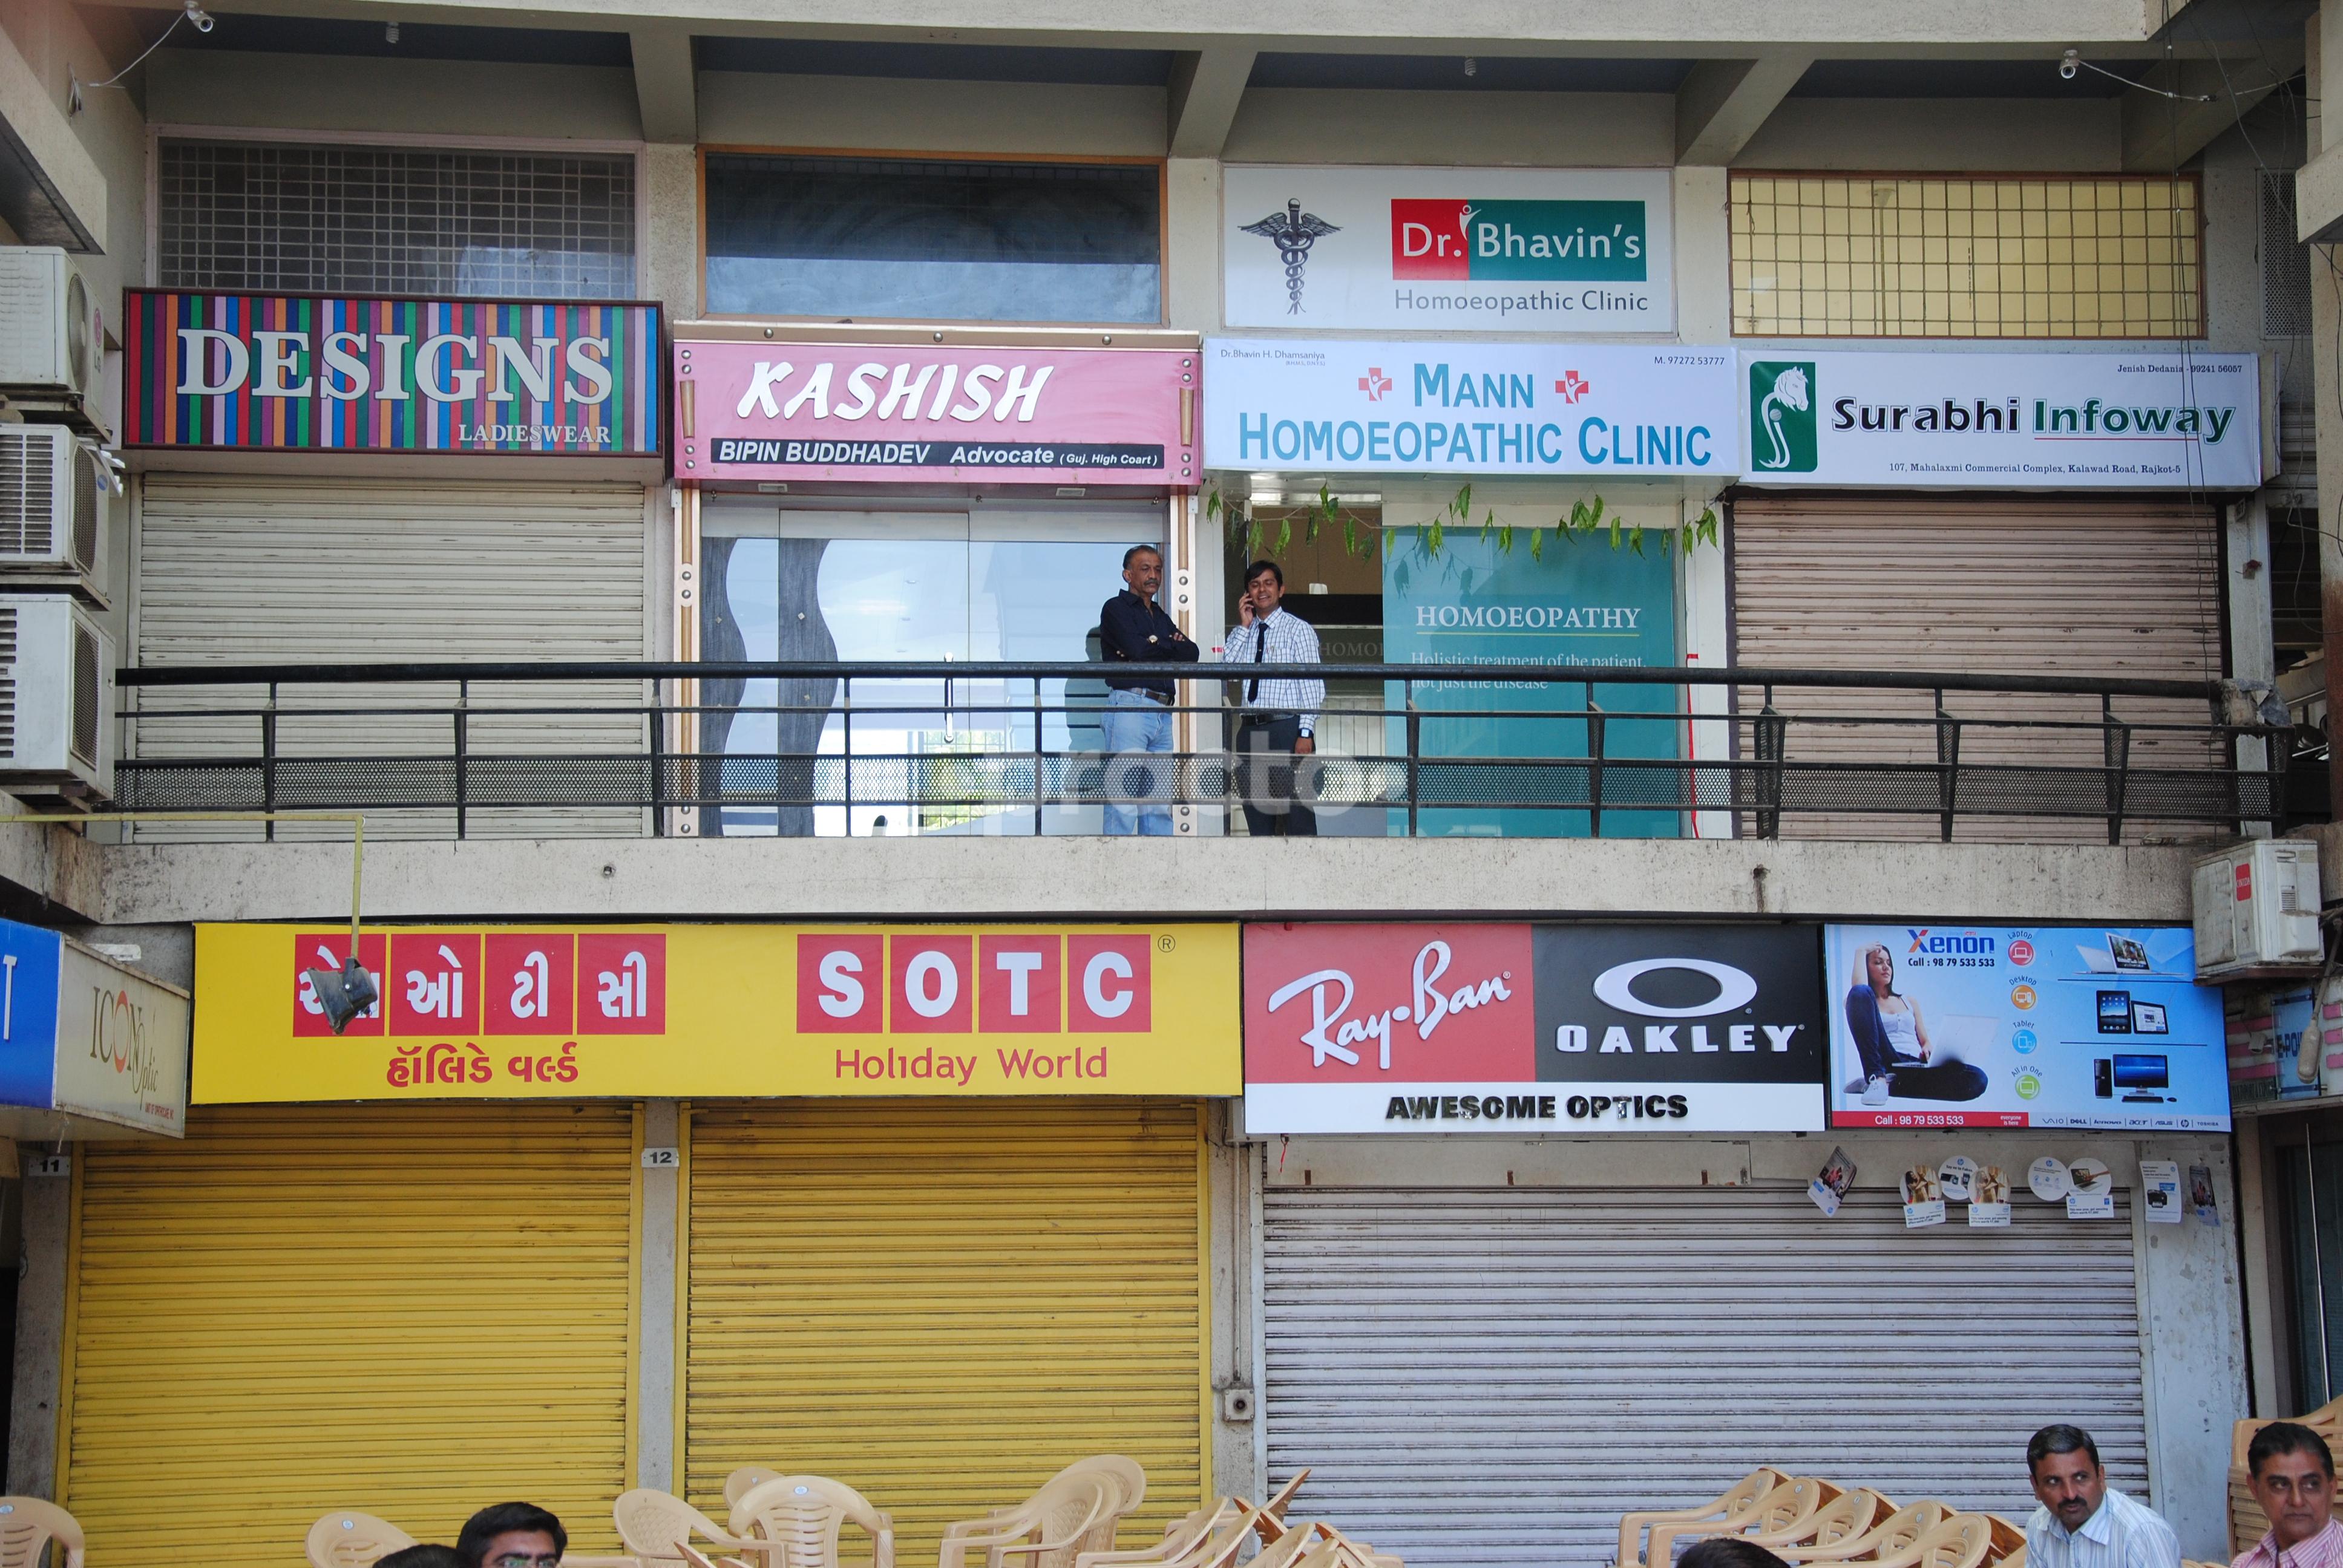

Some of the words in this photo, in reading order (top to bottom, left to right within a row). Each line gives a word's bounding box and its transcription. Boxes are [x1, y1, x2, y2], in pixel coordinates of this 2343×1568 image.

[1402, 222, 1462, 258] Dr.
[1477, 223, 1640, 258] Bhavin's
[1394, 289, 1574, 317] Homoeopathic
[1581, 290, 1648, 311] Clinic
[1262, 350, 1273, 359] H.
[1274, 350, 1325, 361] Dhamsaniya
[1654, 356, 1665, 364] M.
[1667, 356, 1695, 365] 97272
[1697, 356, 1725, 365] 53777
[176, 328, 613, 405] DESIGNS
[2117, 364, 2146, 373] Jenish
[2148, 364, 2183, 373] Dedania
[2191, 365, 2215, 373] 99241
[2218, 365, 2243, 373] 56057
[736, 361, 1055, 423] KASHISH
[1831, 396, 2020, 434] Surabhi
[2032, 398, 2236, 445] Infoway
[458, 424, 611, 443] LADIESWEAR
[1239, 411, 1563, 465] HOMOEOPATHIC
[1578, 416, 1712, 466] CLINIC
[719, 440, 781, 462] BIPIN
[785, 442, 931, 465] BUDDHADEV
[949, 446, 1054, 464] Advocate
[1092, 454, 1117, 466] High
[1889, 463, 1908, 472] 107,
[1910, 463, 1962, 472] Mahalaxmi
[1965, 463, 2020, 472] Commercial
[2022, 464, 2065, 475] Complex,
[2068, 464, 2109, 473] Kalawad
[2111, 465, 2138, 474] Road,
[2141, 465, 2181, 475] Rajkot-5
[1415, 606, 1642, 629] HOMOEOPATHY
[1411, 652, 1470, 665] Holistic
[1473, 653, 1544, 666] treatment
[1547, 653, 1565, 667] of
[1565, 654, 1588, 667] the
[1907, 929, 1995, 954] Xenon
[2007, 930, 2033, 940] Laptop
[1908, 958, 1924, 967] Call
[1932, 958, 1944, 967] 98
[1946, 958, 1958, 967] 79
[1959, 958, 1976, 967] 533
[1978, 958, 1995, 967] 533
[818, 950, 1134, 1018] SOTC
[2008, 975, 2037, 986] Desktop
[90, 985, 142, 1074] ICON
[2013, 1020, 2035, 1029] Tablet
[1555, 1023, 1797, 1054] OAKLEY
[835, 1047, 978, 1087] Holiday
[996, 1046, 1107, 1079] World
[2029, 1065, 2043, 1077] One
[1385, 1094, 1557, 1120] AWESOME
[1565, 1094, 1689, 1120] OPTICS
[1875, 1115, 1893, 1125] Call
[1899, 1116, 1912, 1125] 98
[1913, 1116, 1925, 1125] 79
[1927, 1116, 1944, 1125] 533
[1946, 1116, 1964, 1125] 533
[39, 1159, 60, 1173] 11
[649, 1151, 672, 1164] 12
